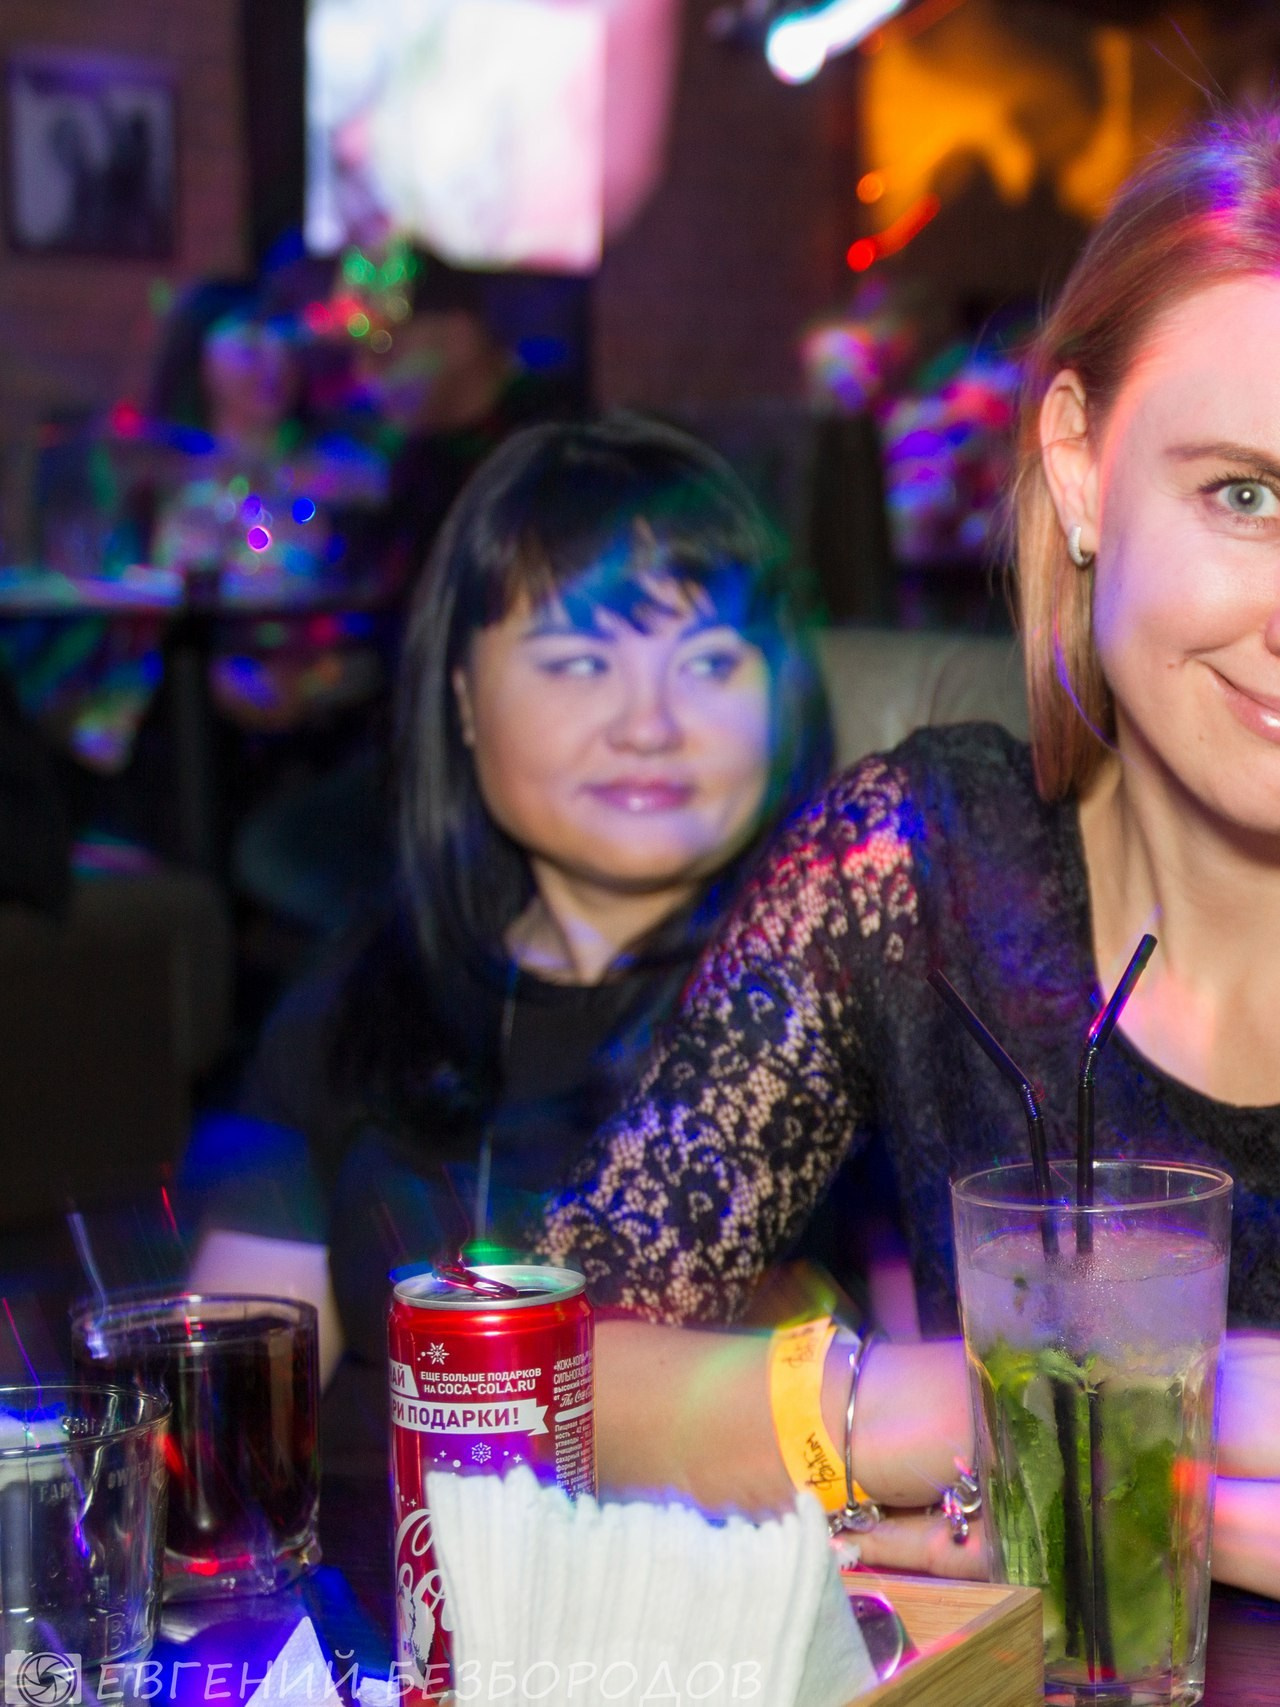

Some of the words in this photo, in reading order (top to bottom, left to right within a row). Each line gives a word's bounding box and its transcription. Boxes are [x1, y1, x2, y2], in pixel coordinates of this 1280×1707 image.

[420, 1371, 440, 1382] ЕЩЕ
[442, 1371, 485, 1383] БОЛЬШЕ
[487, 1368, 542, 1382] ПОДАРКОВ
[424, 1384, 437, 1394] НА
[437, 1379, 537, 1395] COCA-COLA.RU
[408, 1405, 519, 1431] ПОДАРКИ!
